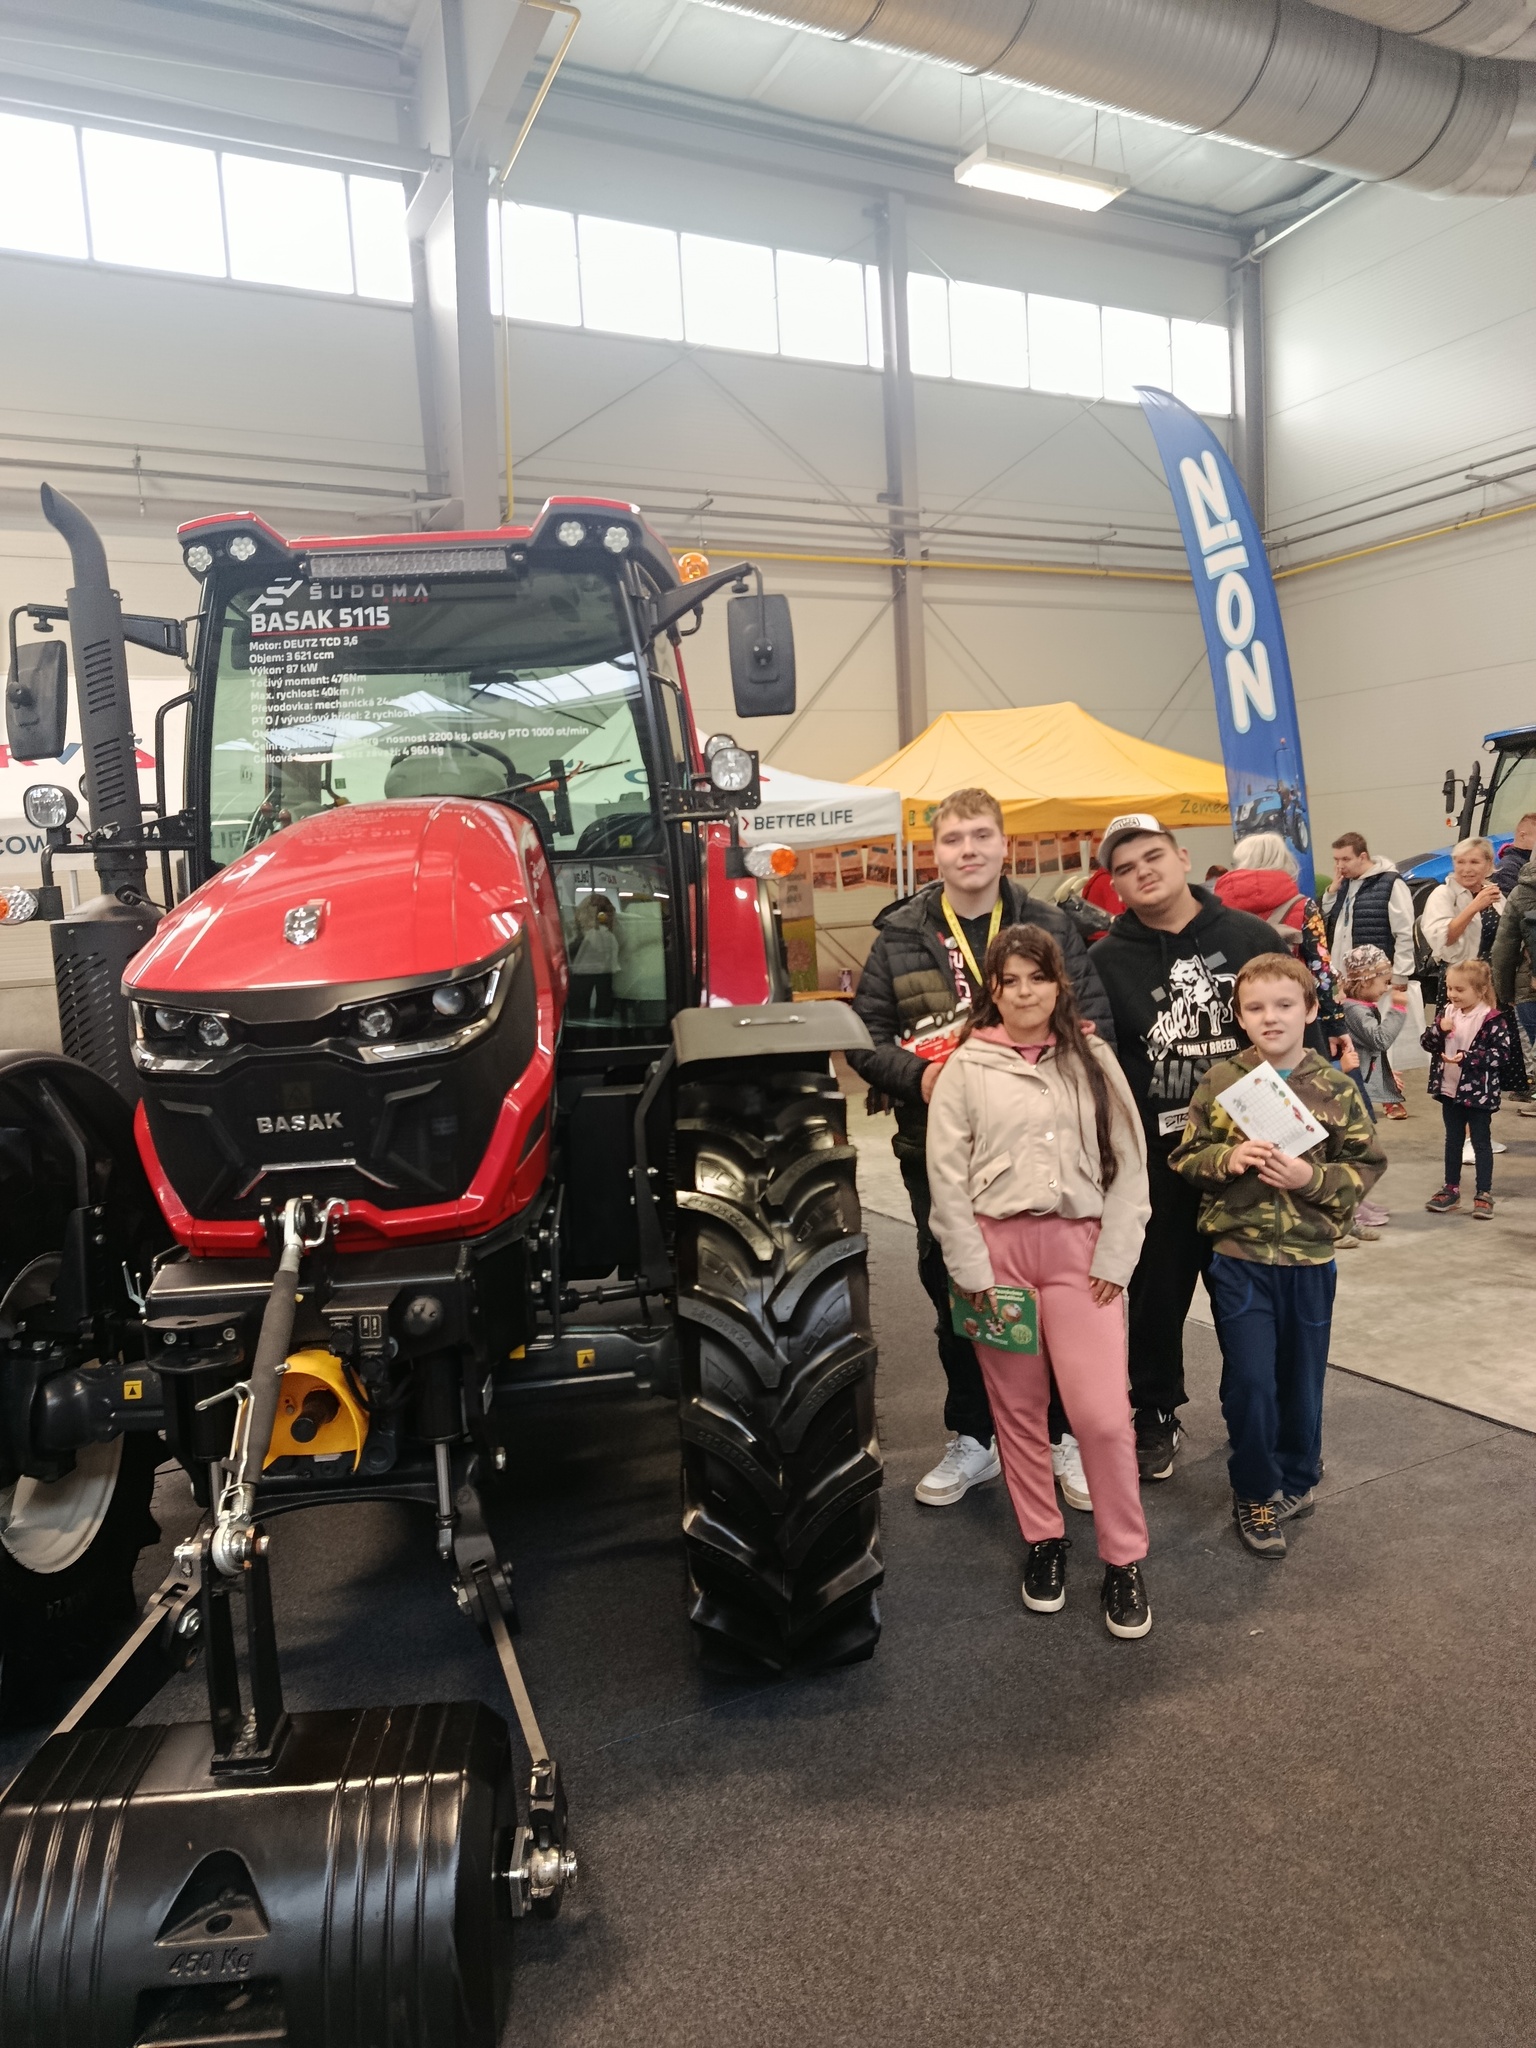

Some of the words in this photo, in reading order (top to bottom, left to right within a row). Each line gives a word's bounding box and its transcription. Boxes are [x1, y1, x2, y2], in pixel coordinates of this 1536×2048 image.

[309, 582, 429, 600] ŠUDOMA
[251, 608, 334, 633] BASAK
[339, 605, 391, 628] 5115
[249, 640, 282, 652] Motor:
[284, 638, 318, 650] DEUTZ
[319, 636, 341, 648] TCD
[343, 635, 359, 647] 3,6
[249, 653, 285, 665] Objem:
[286, 652, 294, 662] 3
[294, 650, 312, 662] 621
[313, 650, 335, 660] ccm
[286, 663, 299, 674] 87
[300, 662, 318, 674] kW
[250, 677, 283, 689] Točivý
[284, 675, 330, 688] moment:
[330, 673, 367, 684] 476Nm
[250, 691, 275, 701] Max.
[276, 687, 320, 701] rychlost:
[320, 686, 350, 698] 40km
[357, 686, 365, 696] h
[251, 701, 313, 714] Převodovka:
[314, 697, 374, 710] mechanická
[251, 716, 274, 727] PTO
[280, 713, 330, 726] vývodový
[364, 710, 371, 719] 2
[386, 733, 427, 744] nosnost
[429, 731, 453, 742] 2200
[453, 731, 471, 743] kg,
[472, 728, 506, 741] otáčky
[507, 728, 529, 738] PTO
[531, 726, 555, 737] 1000
[555, 725, 589, 737] ot/min
[253, 752, 293, 764] Celková
[402, 747, 410, 756] 4
[410, 745, 430, 756] 960
[430, 744, 445, 756] kg
[753, 812, 816, 831] BETTER
[821, 809, 854, 826] LIFE
[0, 836, 45, 855] OW
[1176, 1042, 1208, 1058] FAMILY
[256, 1111, 344, 1134] BASAK
[168, 1950, 215, 1977] 450
